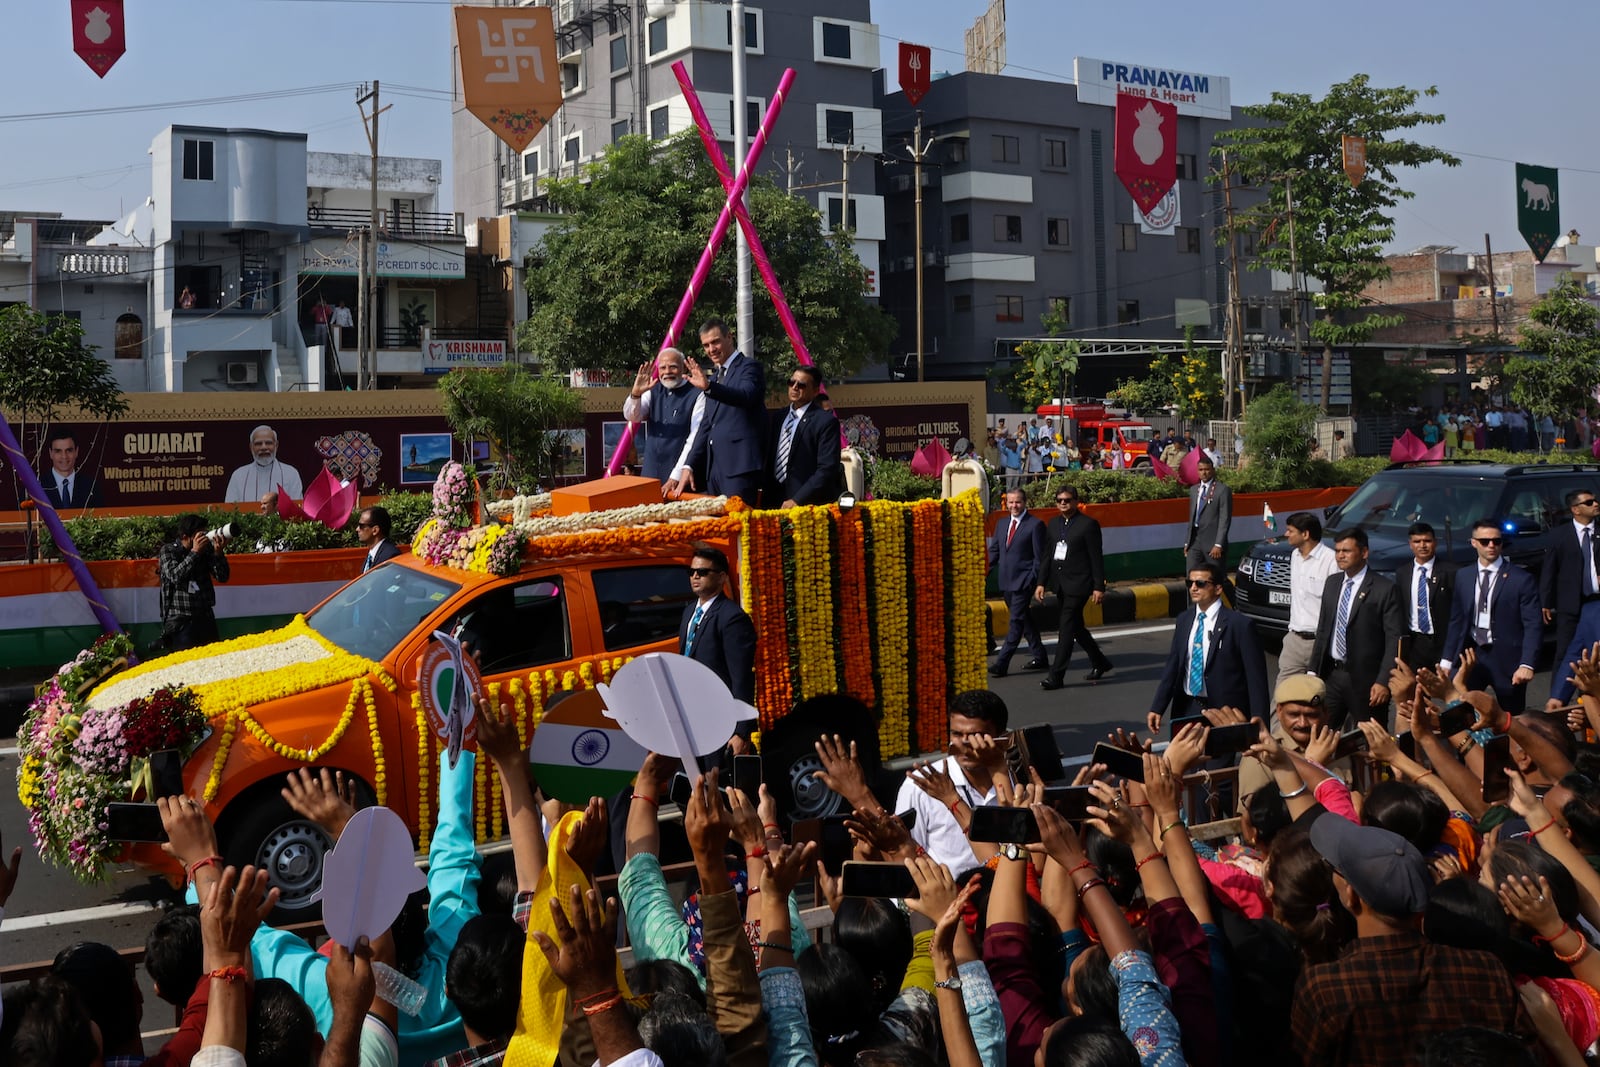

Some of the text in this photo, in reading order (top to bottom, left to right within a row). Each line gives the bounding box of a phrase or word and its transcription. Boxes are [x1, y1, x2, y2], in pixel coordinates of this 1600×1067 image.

[1102, 63, 1209, 93] PRANAYAM
[1117, 83, 1196, 103] Lung & Heart
[303, 258, 320, 267] THE
[323, 258, 353, 268] ROYAL
[443, 263, 461, 271] LTD.
[447, 342, 502, 353] KRISHNAM
[447, 353, 503, 361] DENTAL CLINIC
[885, 422, 961, 437] BRIDGING CULTURES,
[124, 432, 205, 454] GUJARAT
[886, 441, 916, 453] BUILDING
[104, 465, 224, 479] Where Heritage Meets
[119, 478, 211, 492] VIBRANT CULTURE
